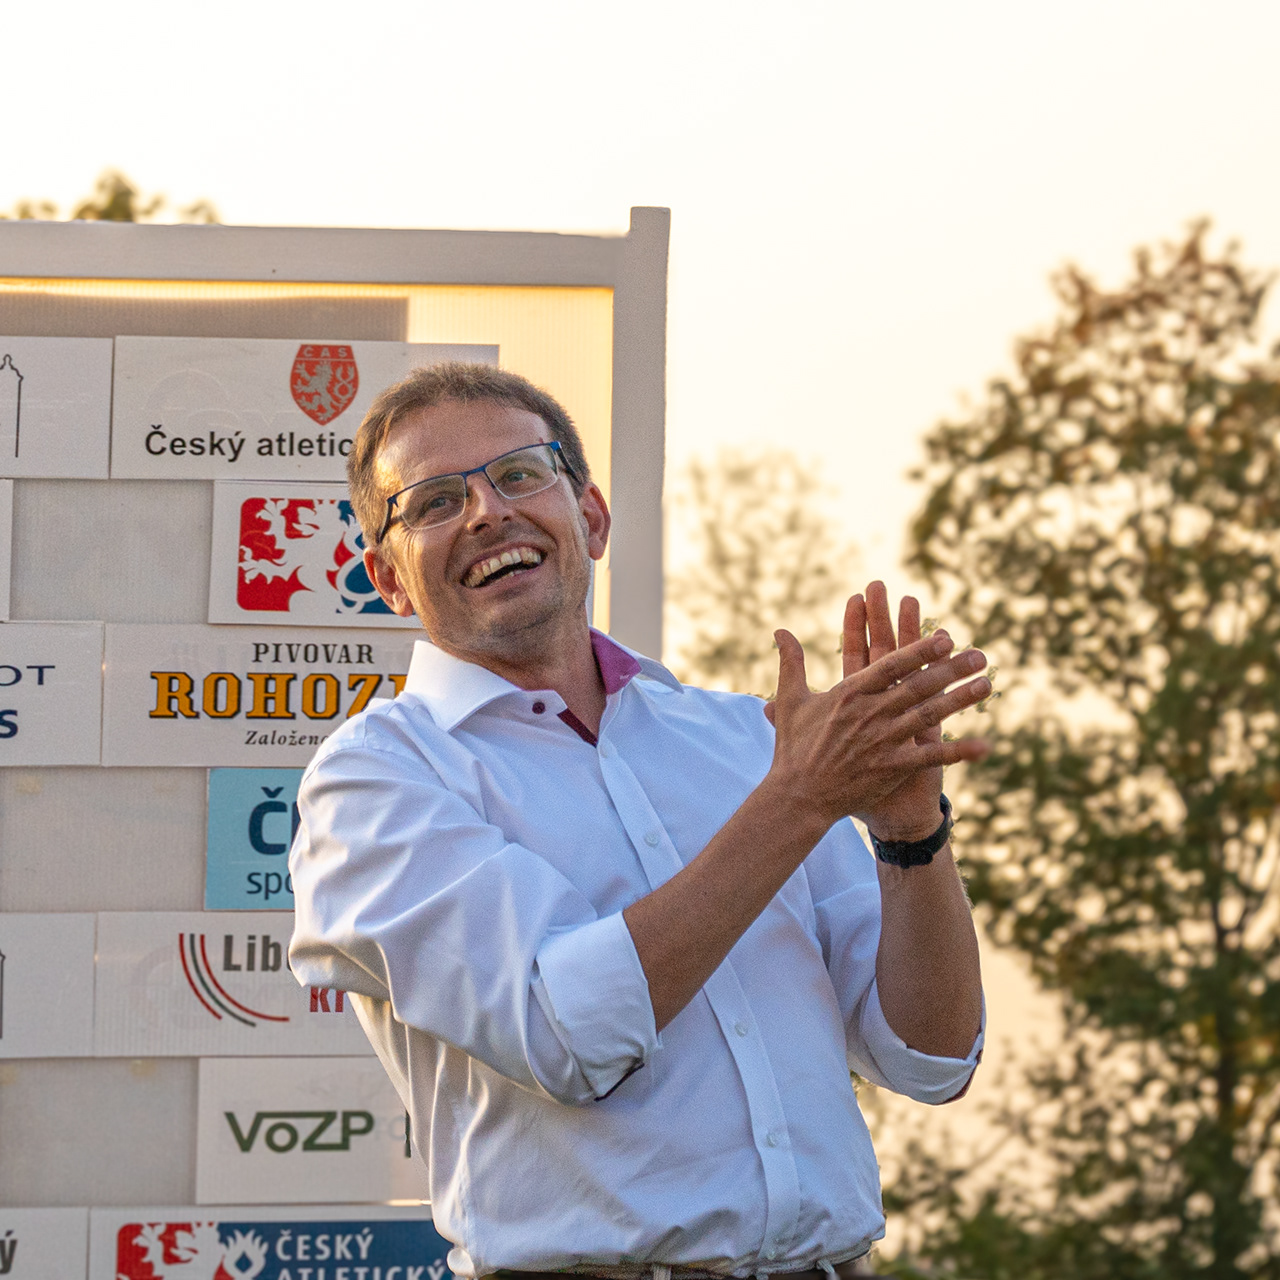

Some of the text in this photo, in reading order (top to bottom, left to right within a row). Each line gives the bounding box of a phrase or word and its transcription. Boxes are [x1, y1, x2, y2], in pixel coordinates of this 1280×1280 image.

[145, 424, 354, 462] Český atletic
[252, 642, 376, 665] PIVOVAR
[149, 670, 409, 720] ROHOZ
[275, 1226, 374, 1261] ČESKÝ
